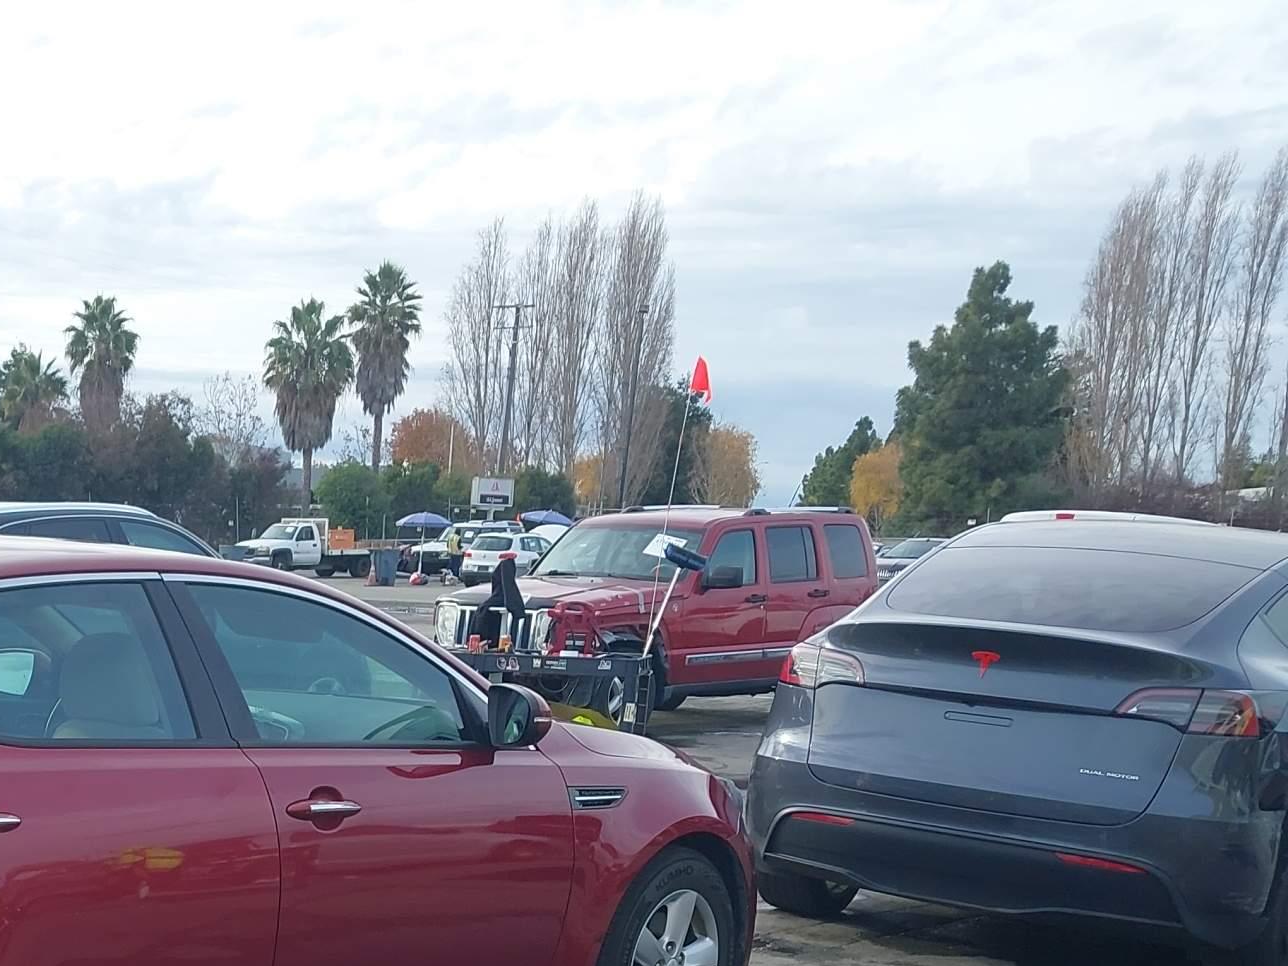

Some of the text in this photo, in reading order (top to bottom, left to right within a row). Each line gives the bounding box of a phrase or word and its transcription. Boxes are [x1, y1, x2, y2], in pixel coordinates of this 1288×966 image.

[1079, 768, 1140, 781] DUAL MOTOR
[655, 864, 694, 892] KUMHO
